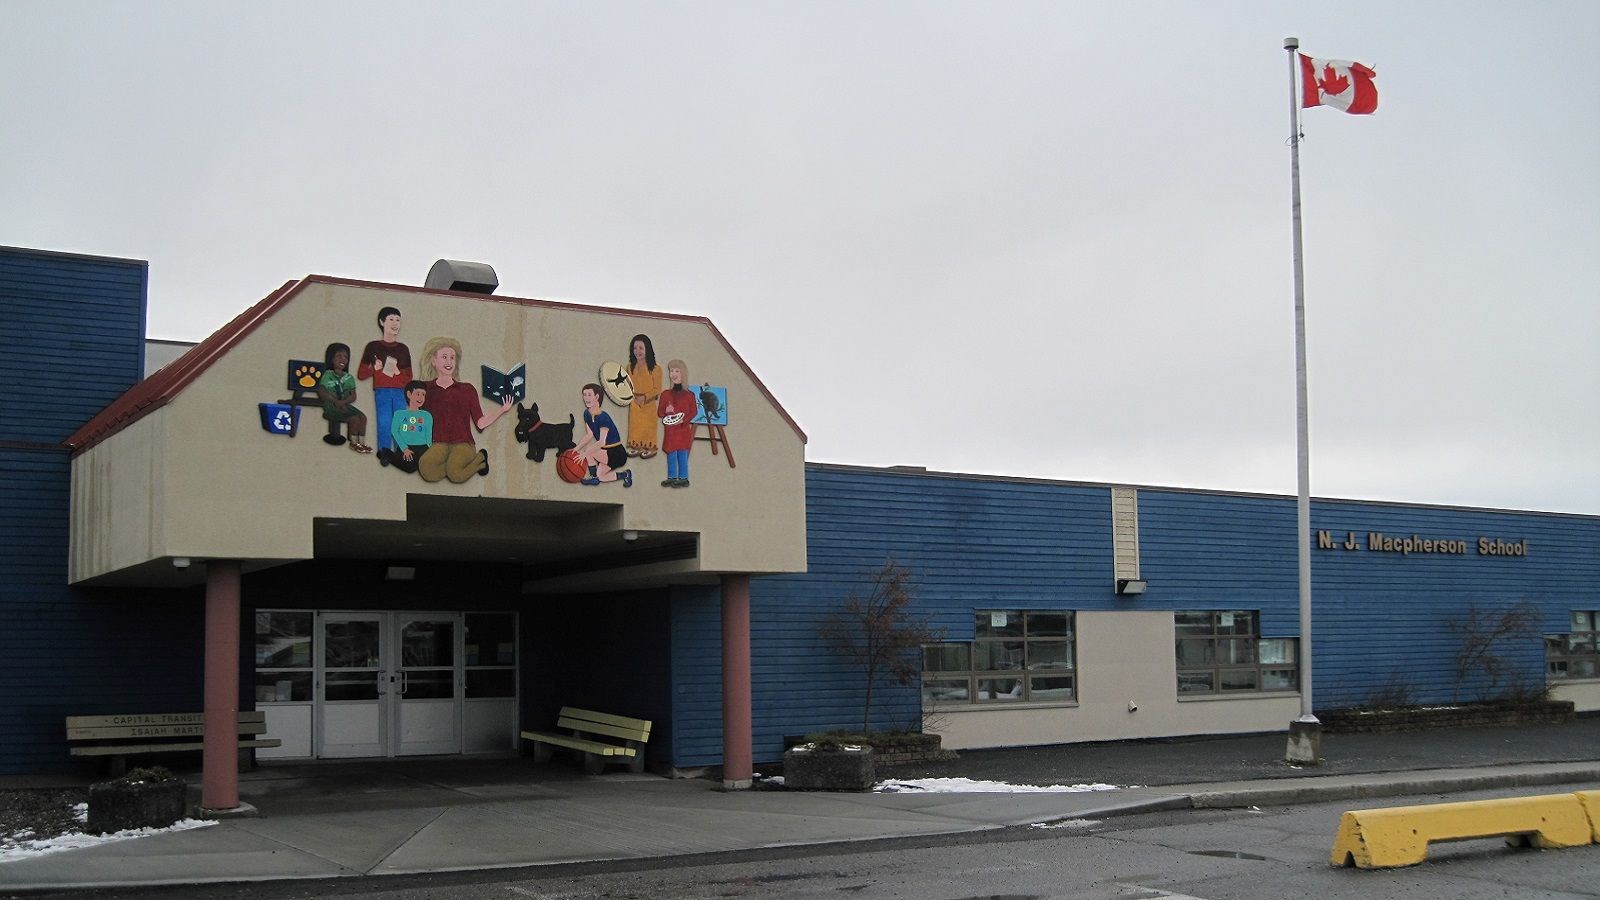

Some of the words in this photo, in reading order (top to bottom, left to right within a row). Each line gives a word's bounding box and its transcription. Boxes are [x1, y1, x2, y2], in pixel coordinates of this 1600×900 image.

[1318, 530, 1337, 549] N.
[1344, 532, 1360, 550] J.
[1368, 532, 1467, 555] Macpherson
[1478, 536, 1528, 556] School
[113, 716, 156, 725] CAPITAL
[162, 714, 203, 722] TRANSIT
[131, 727, 167, 736] ISAIAH
